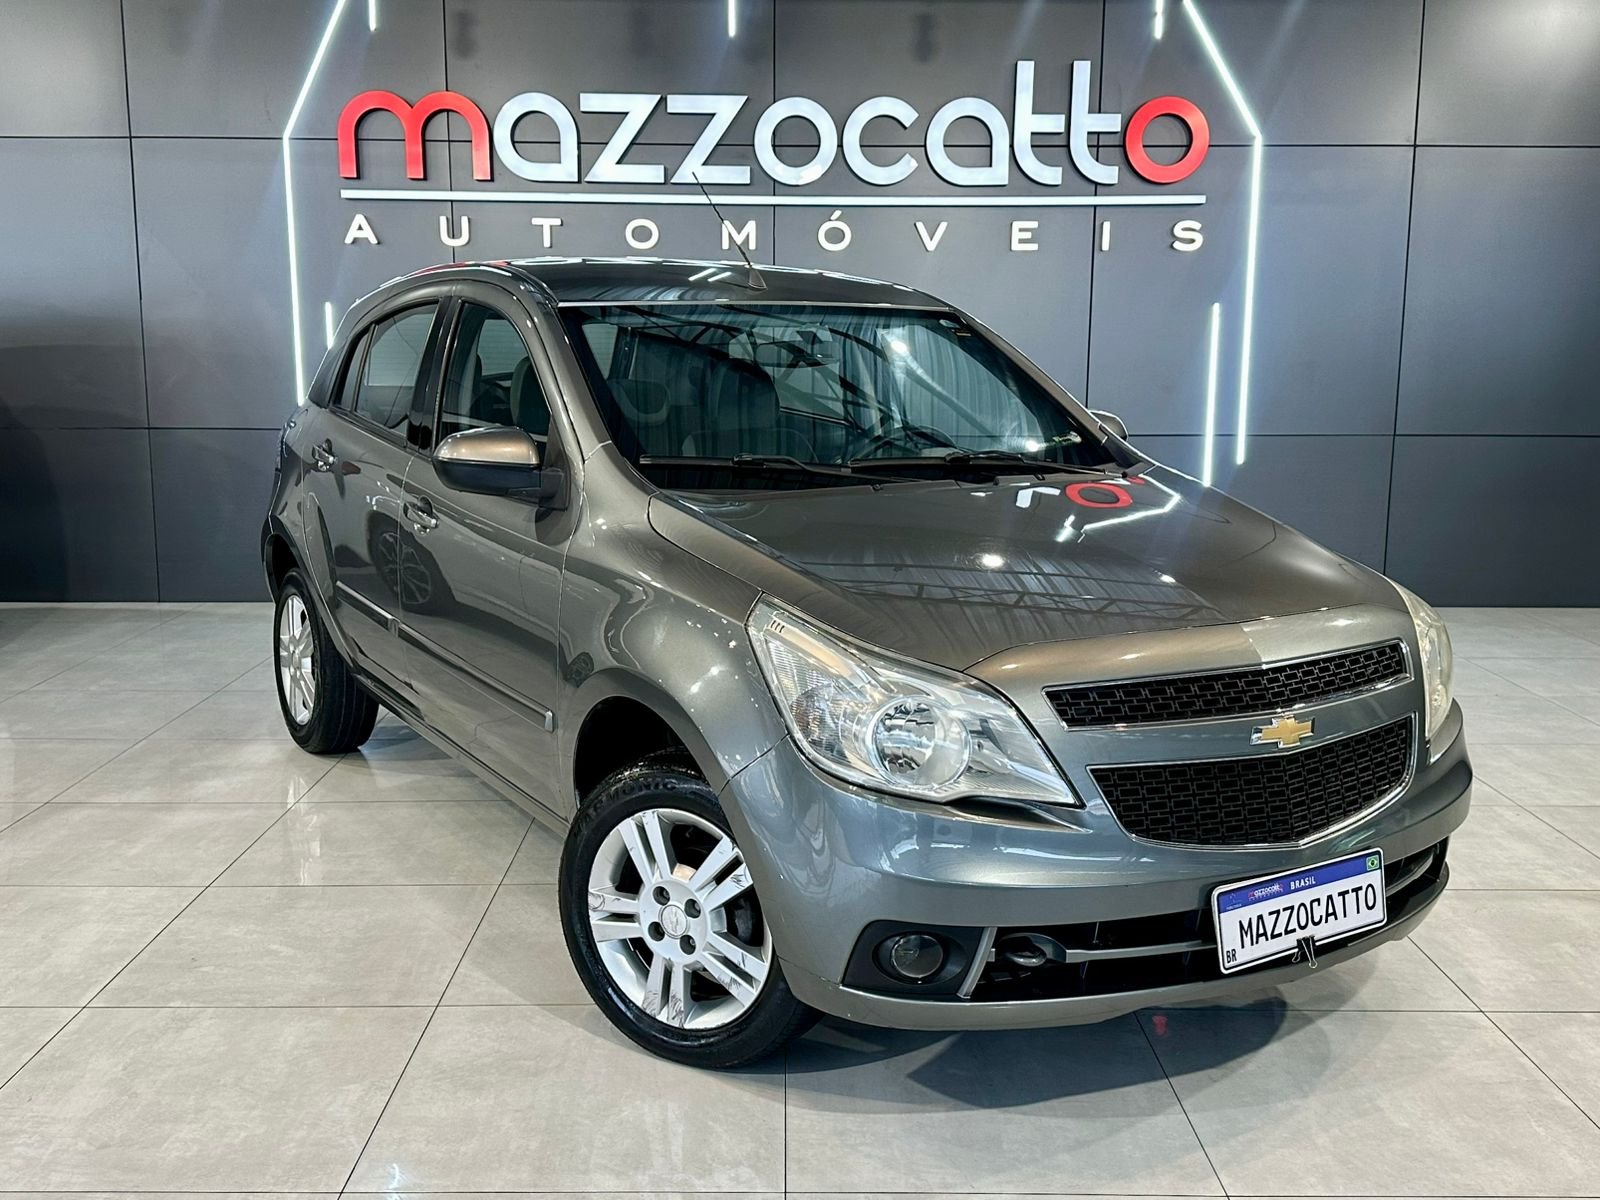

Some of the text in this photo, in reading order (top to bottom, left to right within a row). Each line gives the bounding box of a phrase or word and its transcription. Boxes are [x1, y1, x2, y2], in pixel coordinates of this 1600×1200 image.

[338, 60, 1210, 187] mazzocatto
[344, 211, 1204, 252] AUTOMÓVEIS
[1290, 876, 1316, 890] BRASIL
[1239, 883, 1377, 949] MAZZOCATTO
[1226, 949, 1237, 964] BR
